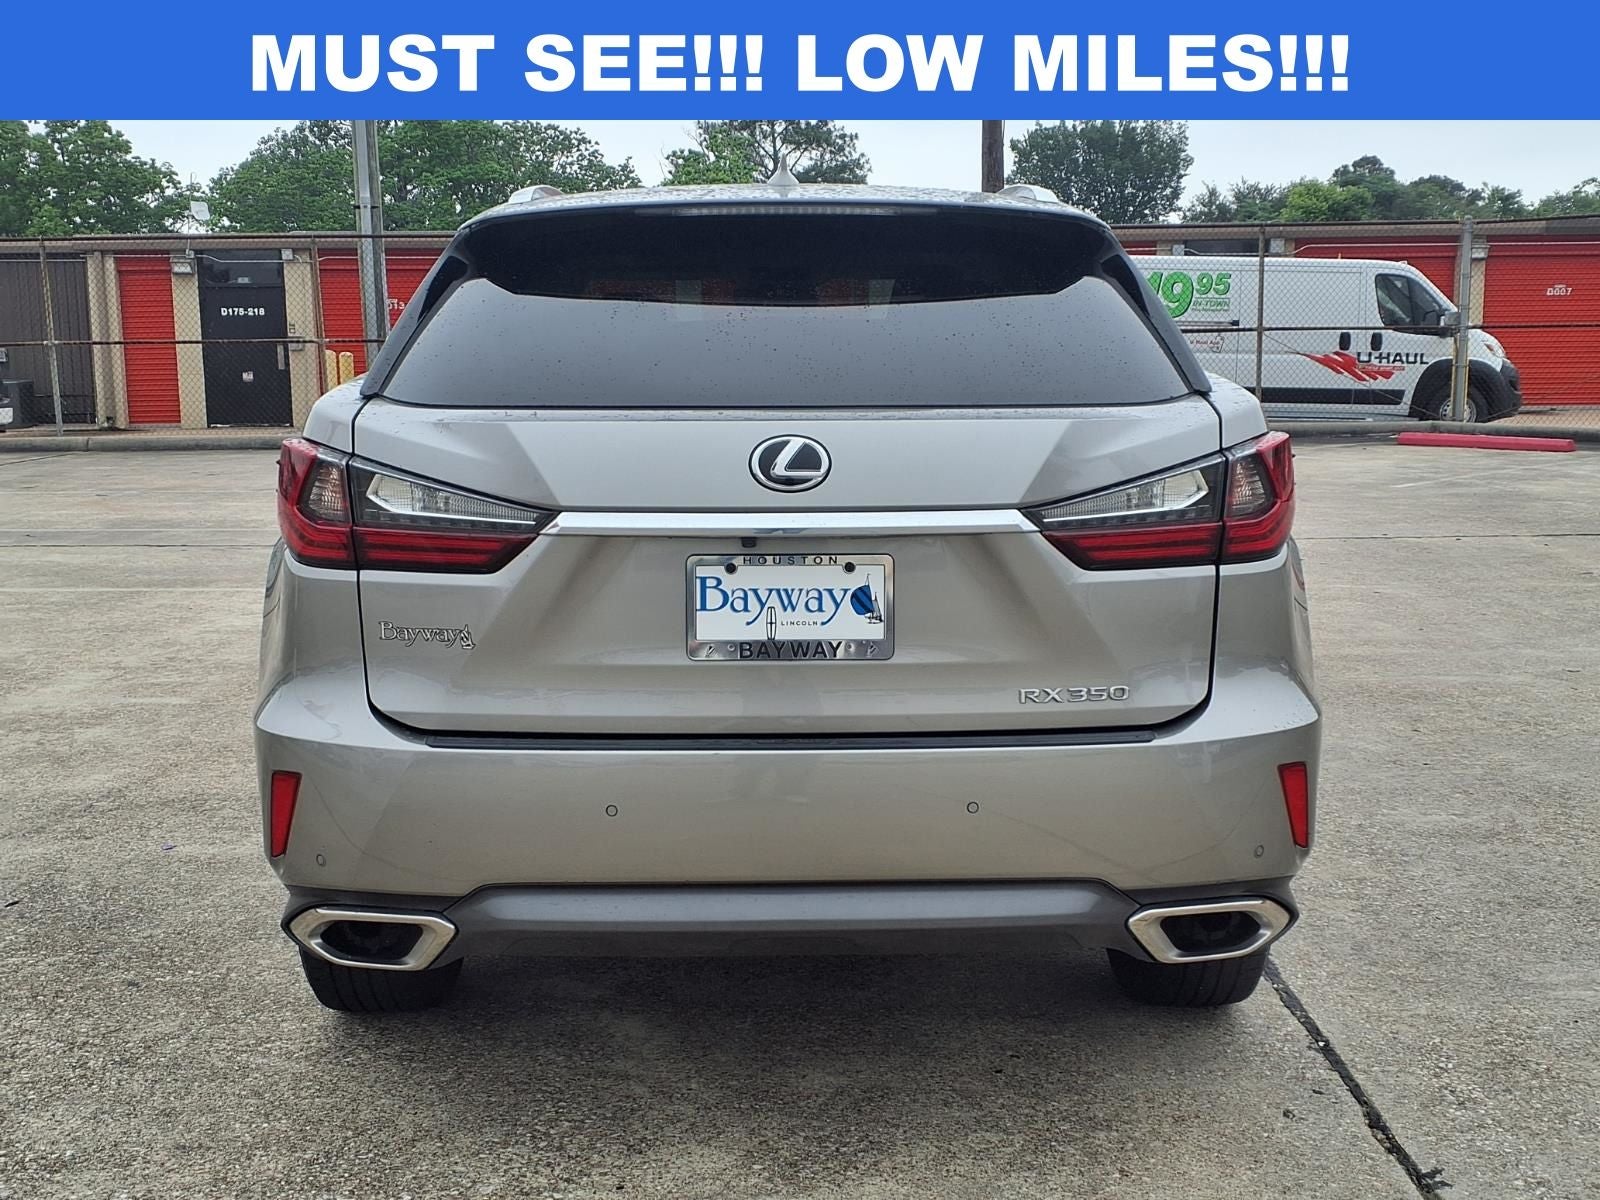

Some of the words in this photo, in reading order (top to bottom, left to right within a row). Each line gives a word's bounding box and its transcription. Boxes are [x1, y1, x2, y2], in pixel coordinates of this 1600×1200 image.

[220, 307, 265, 316] D175-218
[1357, 351, 1429, 365] U-HAUL
[743, 555, 839, 565] HOUSTON
[695, 575, 852, 626] Bayway
[379, 620, 461, 648] Bayway
[738, 640, 844, 659] BAYWAY
[1019, 687, 1064, 704] RX
[1066, 685, 1129, 702] 350
